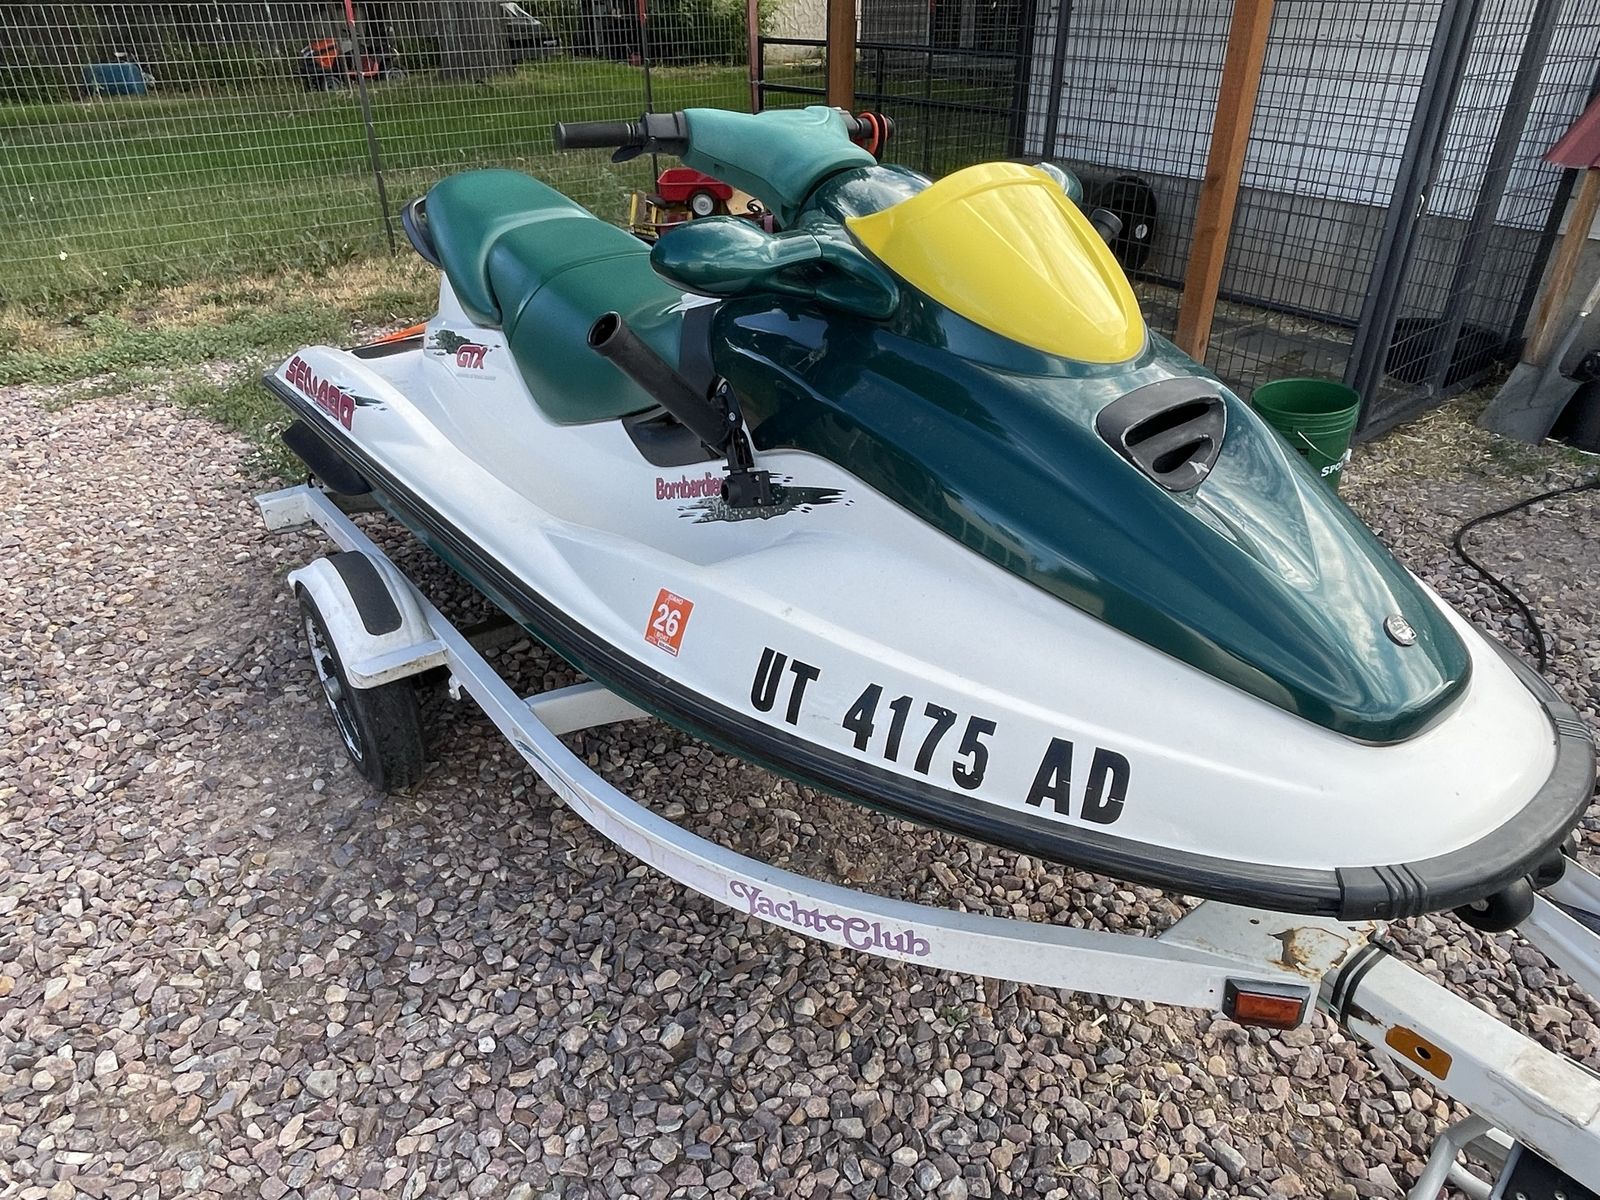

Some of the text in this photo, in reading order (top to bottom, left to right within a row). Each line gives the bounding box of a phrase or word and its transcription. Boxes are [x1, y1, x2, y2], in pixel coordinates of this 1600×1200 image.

[457, 345, 488, 370] GTX
[652, 603, 682, 637] 26
[750, 646, 1131, 825] UT 4175 AD
